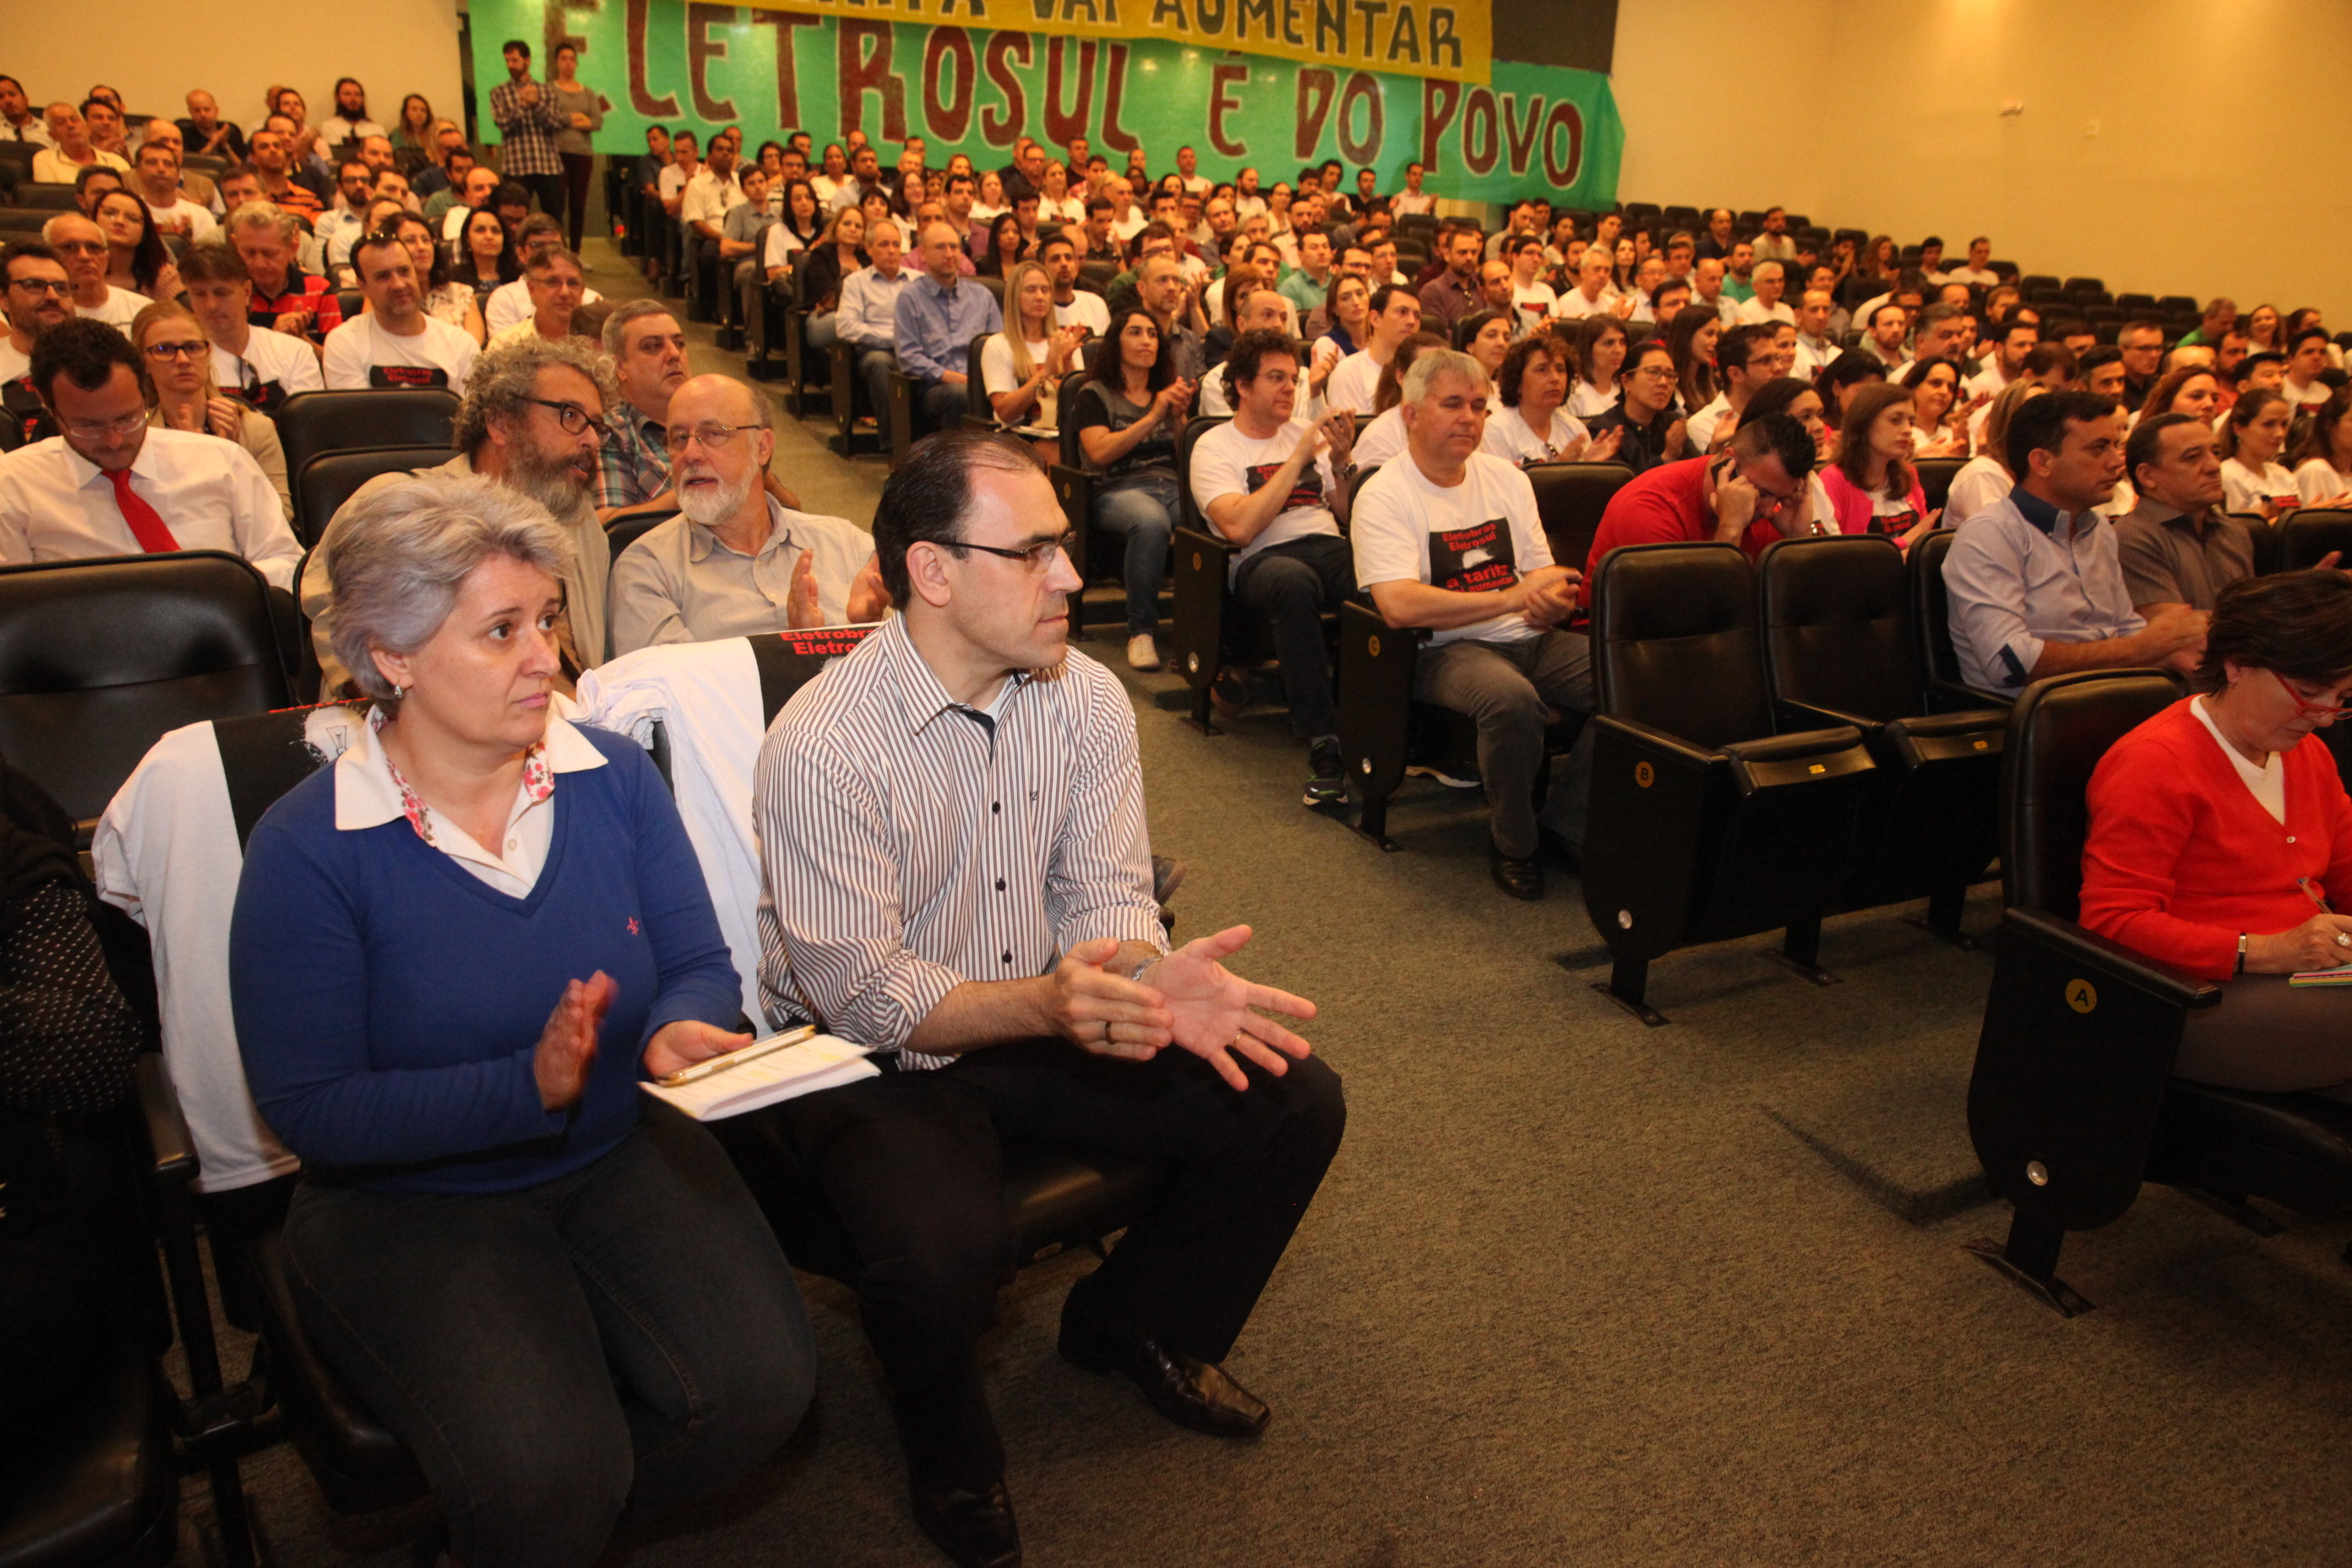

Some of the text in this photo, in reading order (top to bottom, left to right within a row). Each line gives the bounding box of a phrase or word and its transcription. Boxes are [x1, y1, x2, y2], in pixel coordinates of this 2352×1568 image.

[1293, 68, 1386, 167] DO
[1421, 77, 1586, 189] POVO
[779, 629, 875, 642] Eletrobr
[792, 641, 857, 655] Eletro
[1641, 766, 1649, 781] B
[2074, 988, 2089, 1007] A
